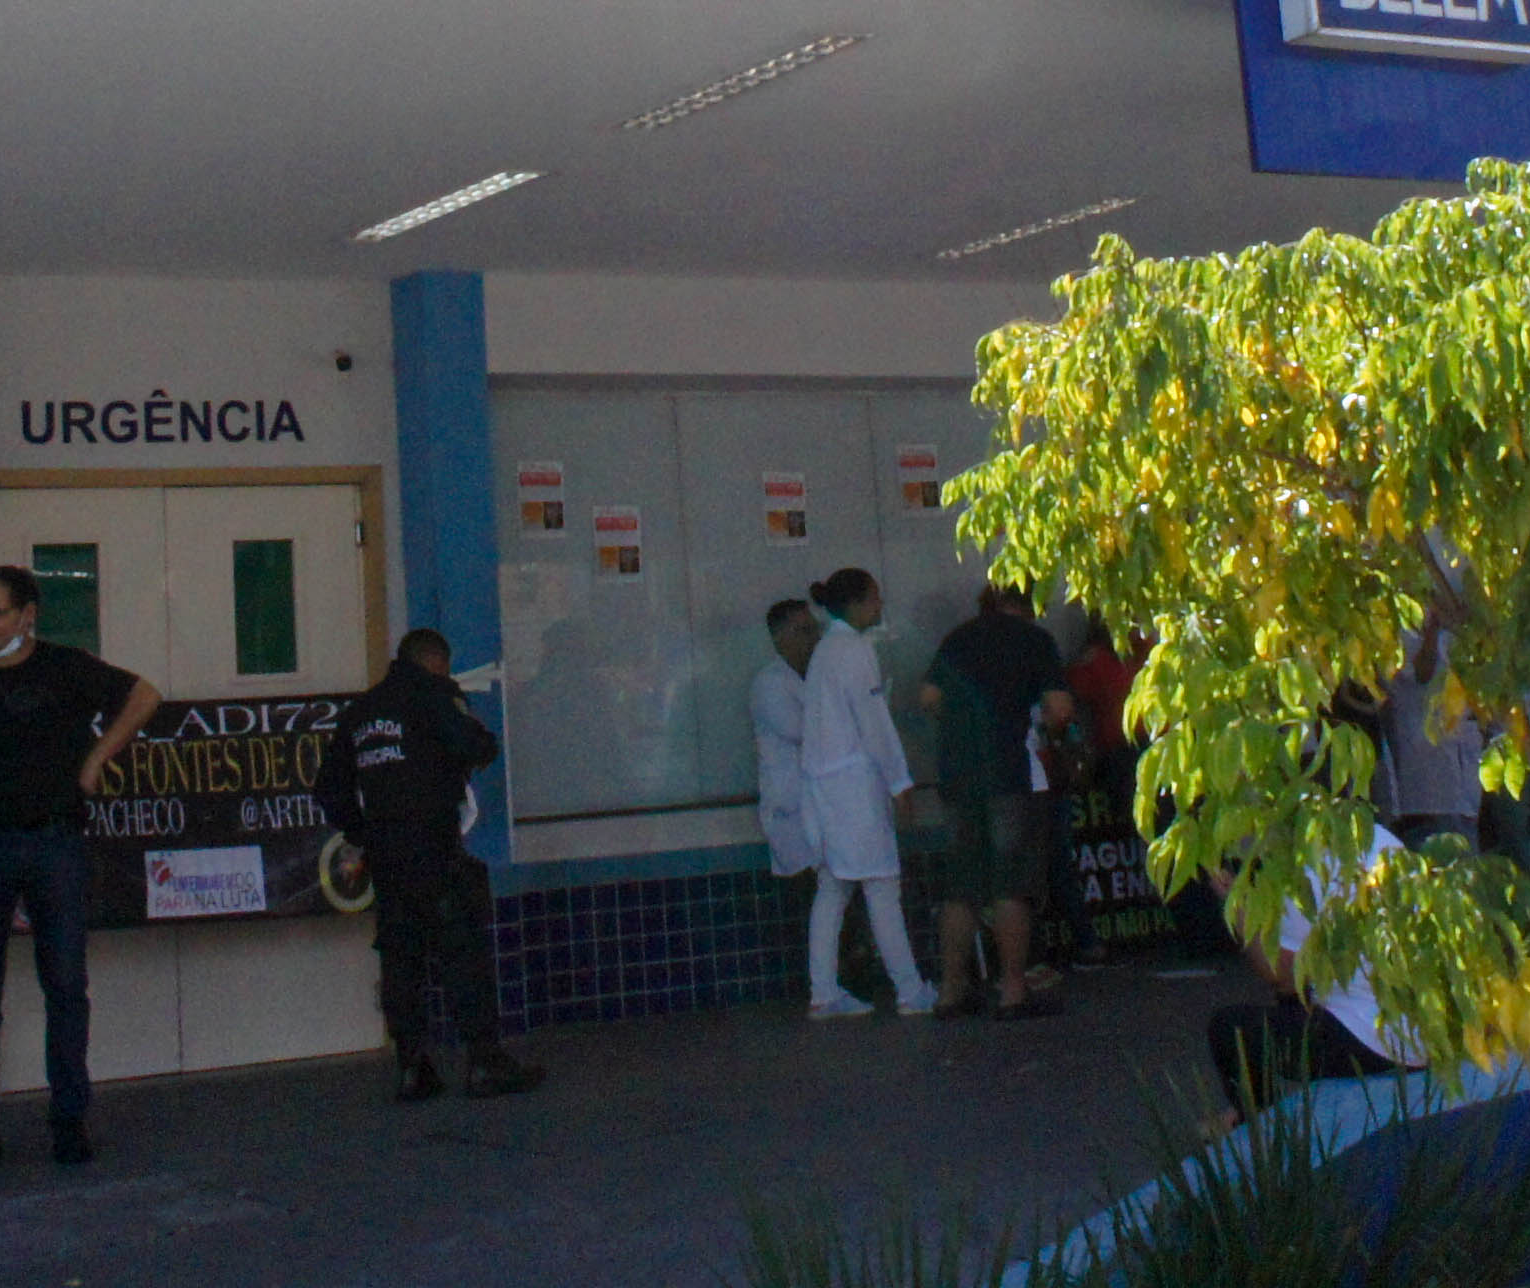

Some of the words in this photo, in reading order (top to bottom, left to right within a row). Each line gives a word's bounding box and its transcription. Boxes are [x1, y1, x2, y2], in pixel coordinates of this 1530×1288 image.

[20, 389, 305, 445] URGÊNCIA
[131, 737, 242, 796] FONTES
[249, 736, 290, 790] DE
